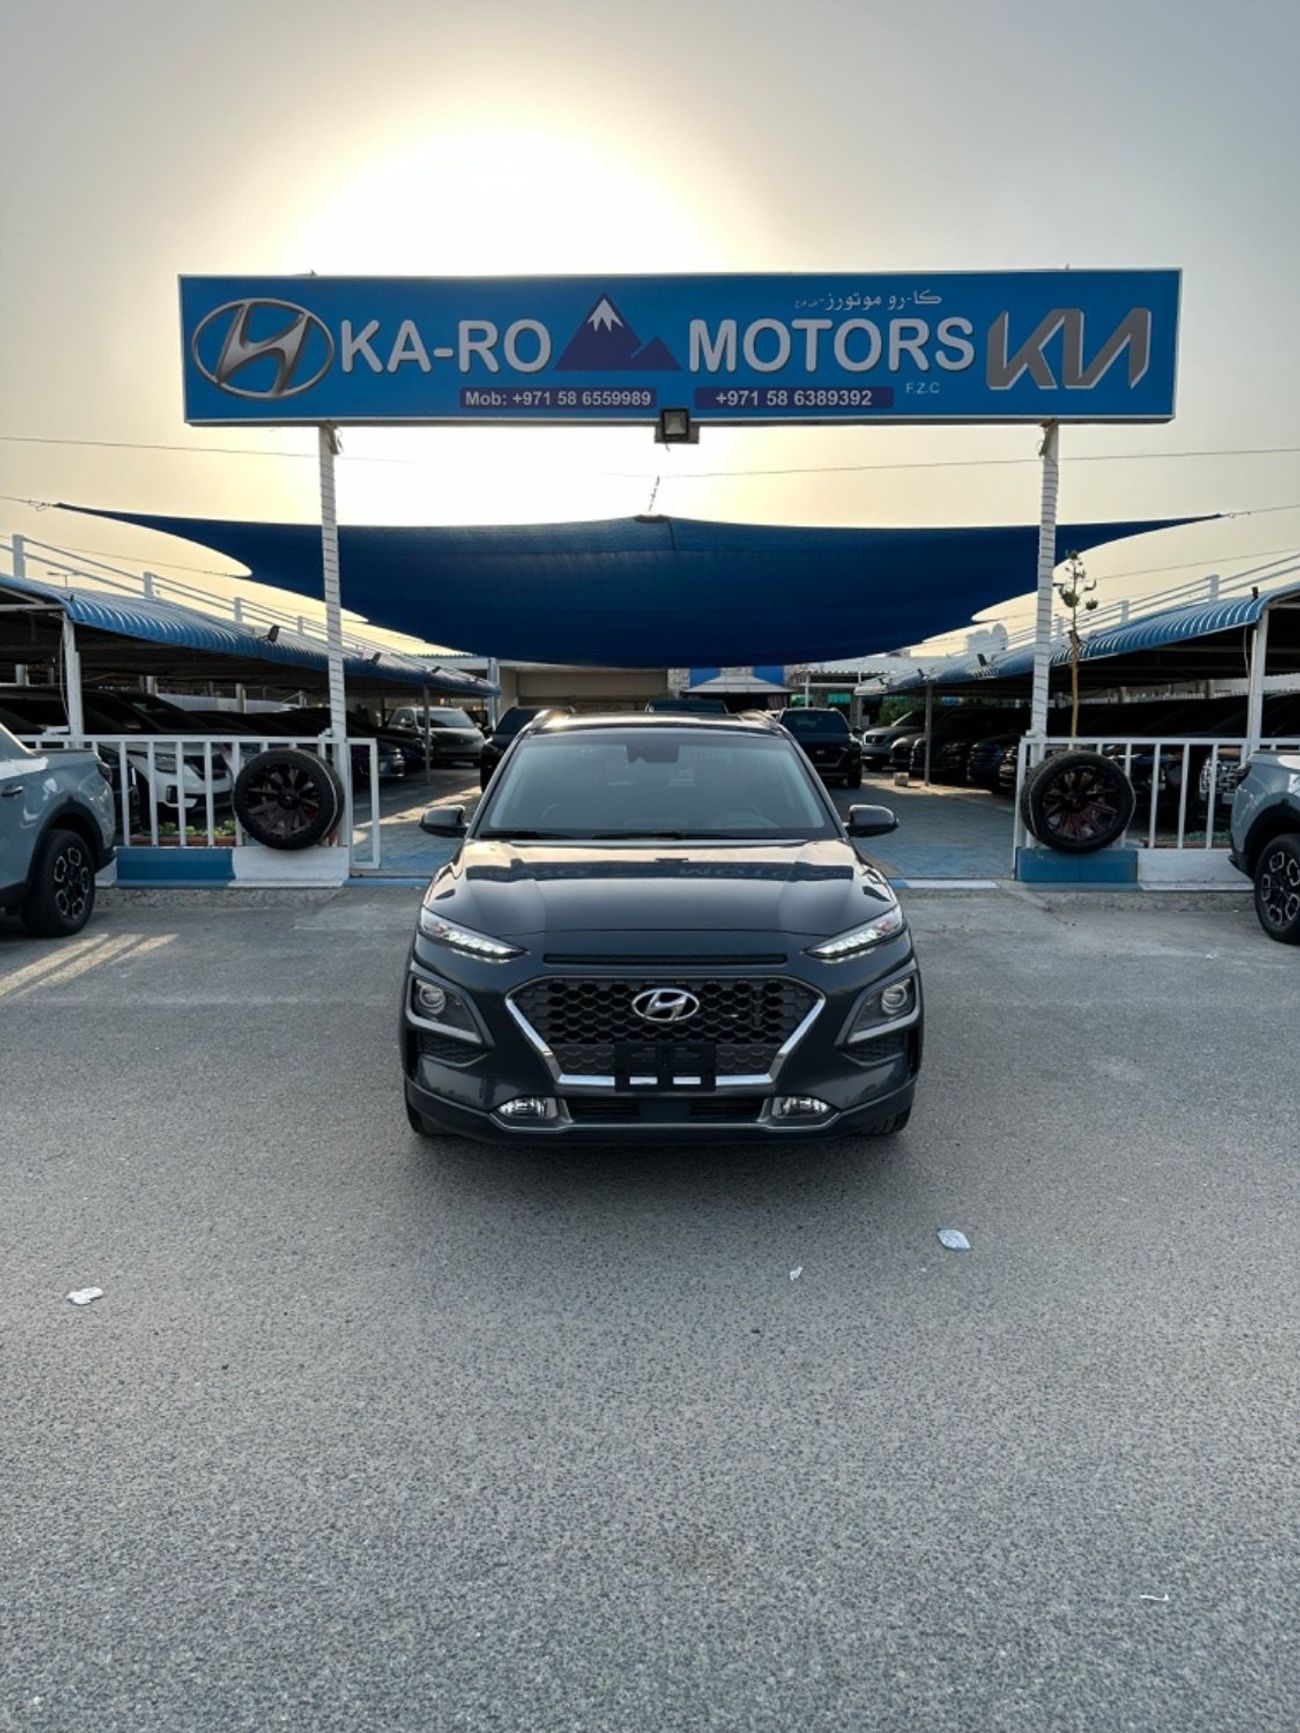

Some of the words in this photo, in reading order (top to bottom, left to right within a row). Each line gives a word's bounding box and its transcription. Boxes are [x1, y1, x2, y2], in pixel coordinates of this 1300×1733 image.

[340, 318, 552, 374] KA-RO
[689, 316, 976, 373] MOTORS
[465, 391, 507, 406] Mob:
[512, 391, 551, 406] +971
[557, 391, 577, 406] 58
[582, 391, 652, 406] 6559989
[715, 390, 758, 406] +971
[766, 390, 788, 406] 58
[794, 390, 872, 406] 6389392
